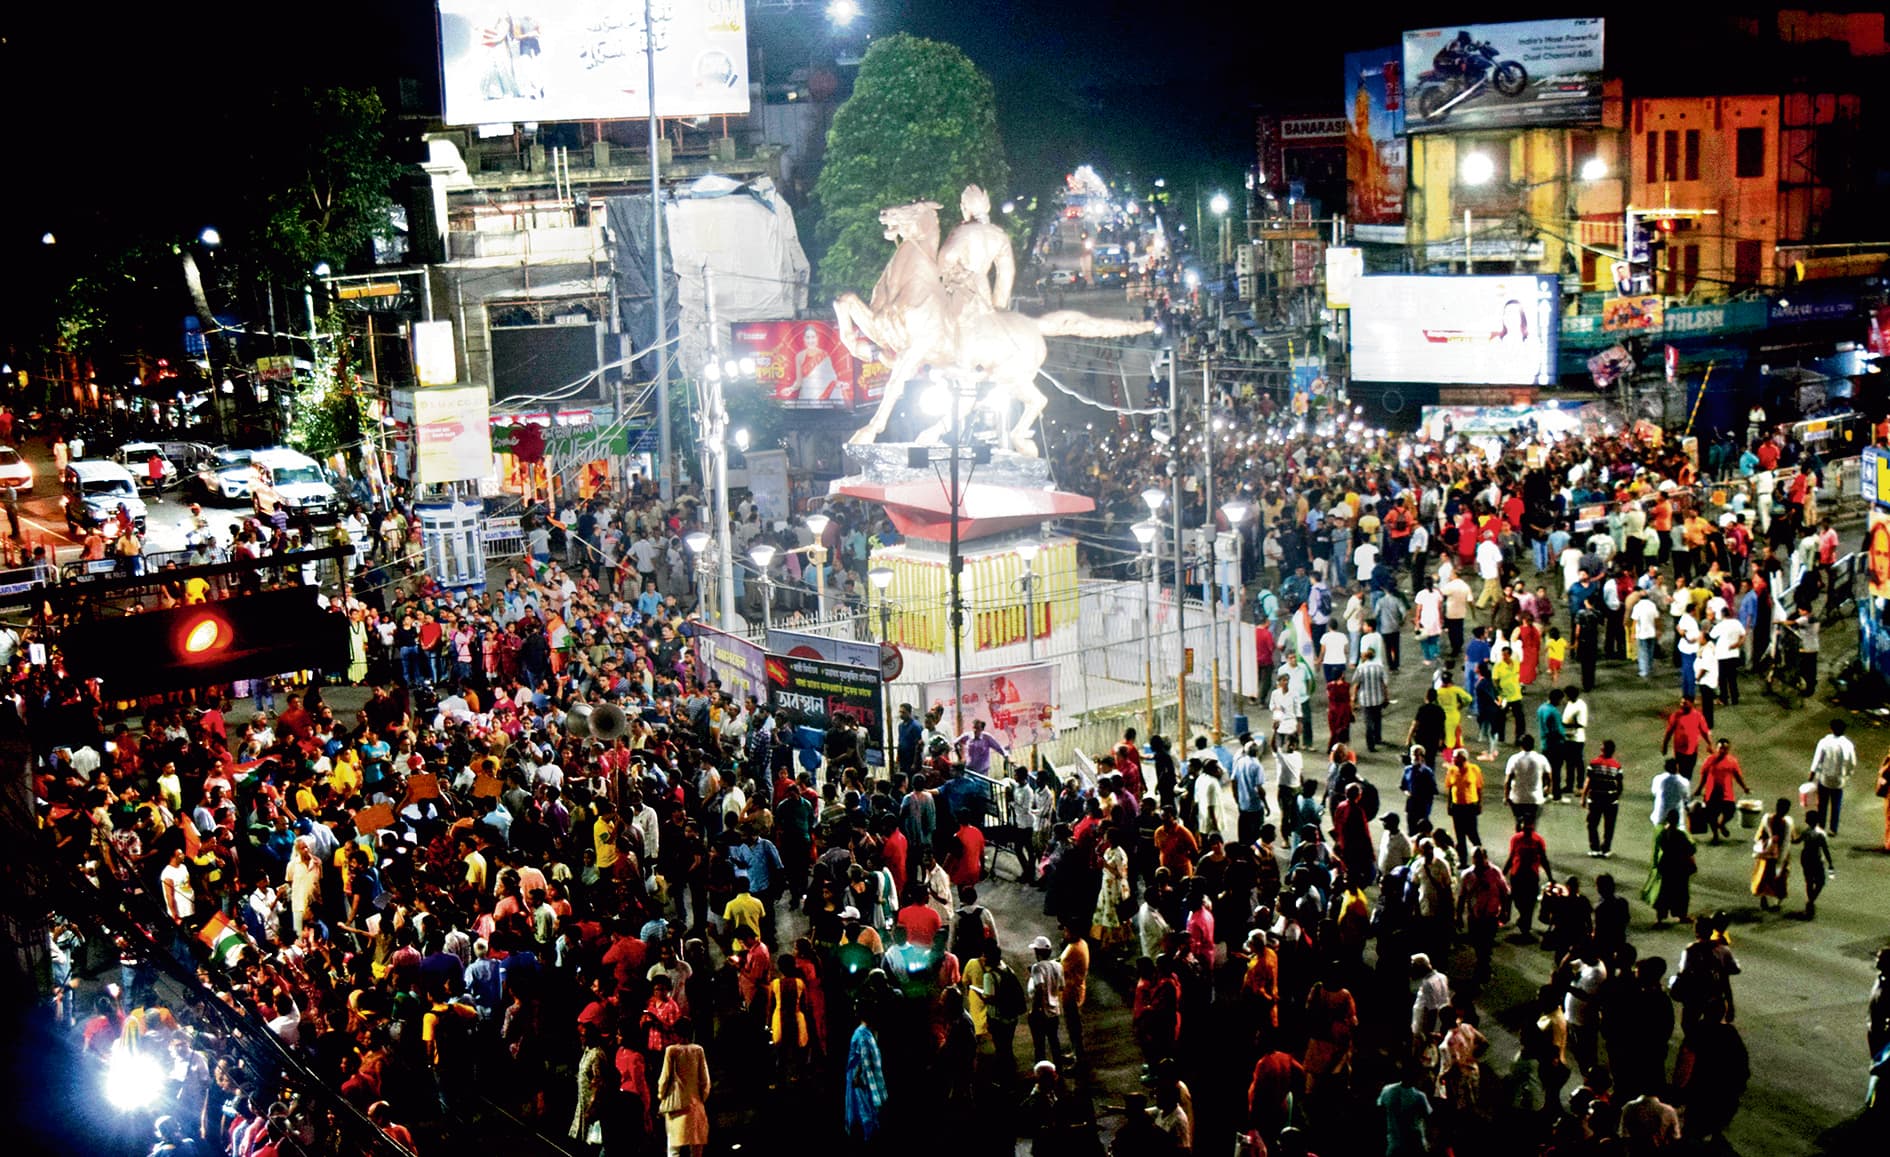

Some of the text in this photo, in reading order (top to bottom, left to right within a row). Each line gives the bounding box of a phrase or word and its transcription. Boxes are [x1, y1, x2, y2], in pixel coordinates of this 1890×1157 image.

[1518, 33, 1599, 45] India's Most Powerful
[1523, 50, 1593, 61] Dual Channel ABS
[544, 435, 621, 475] Kolkata
[776, 690, 825, 716] অবস্থান
